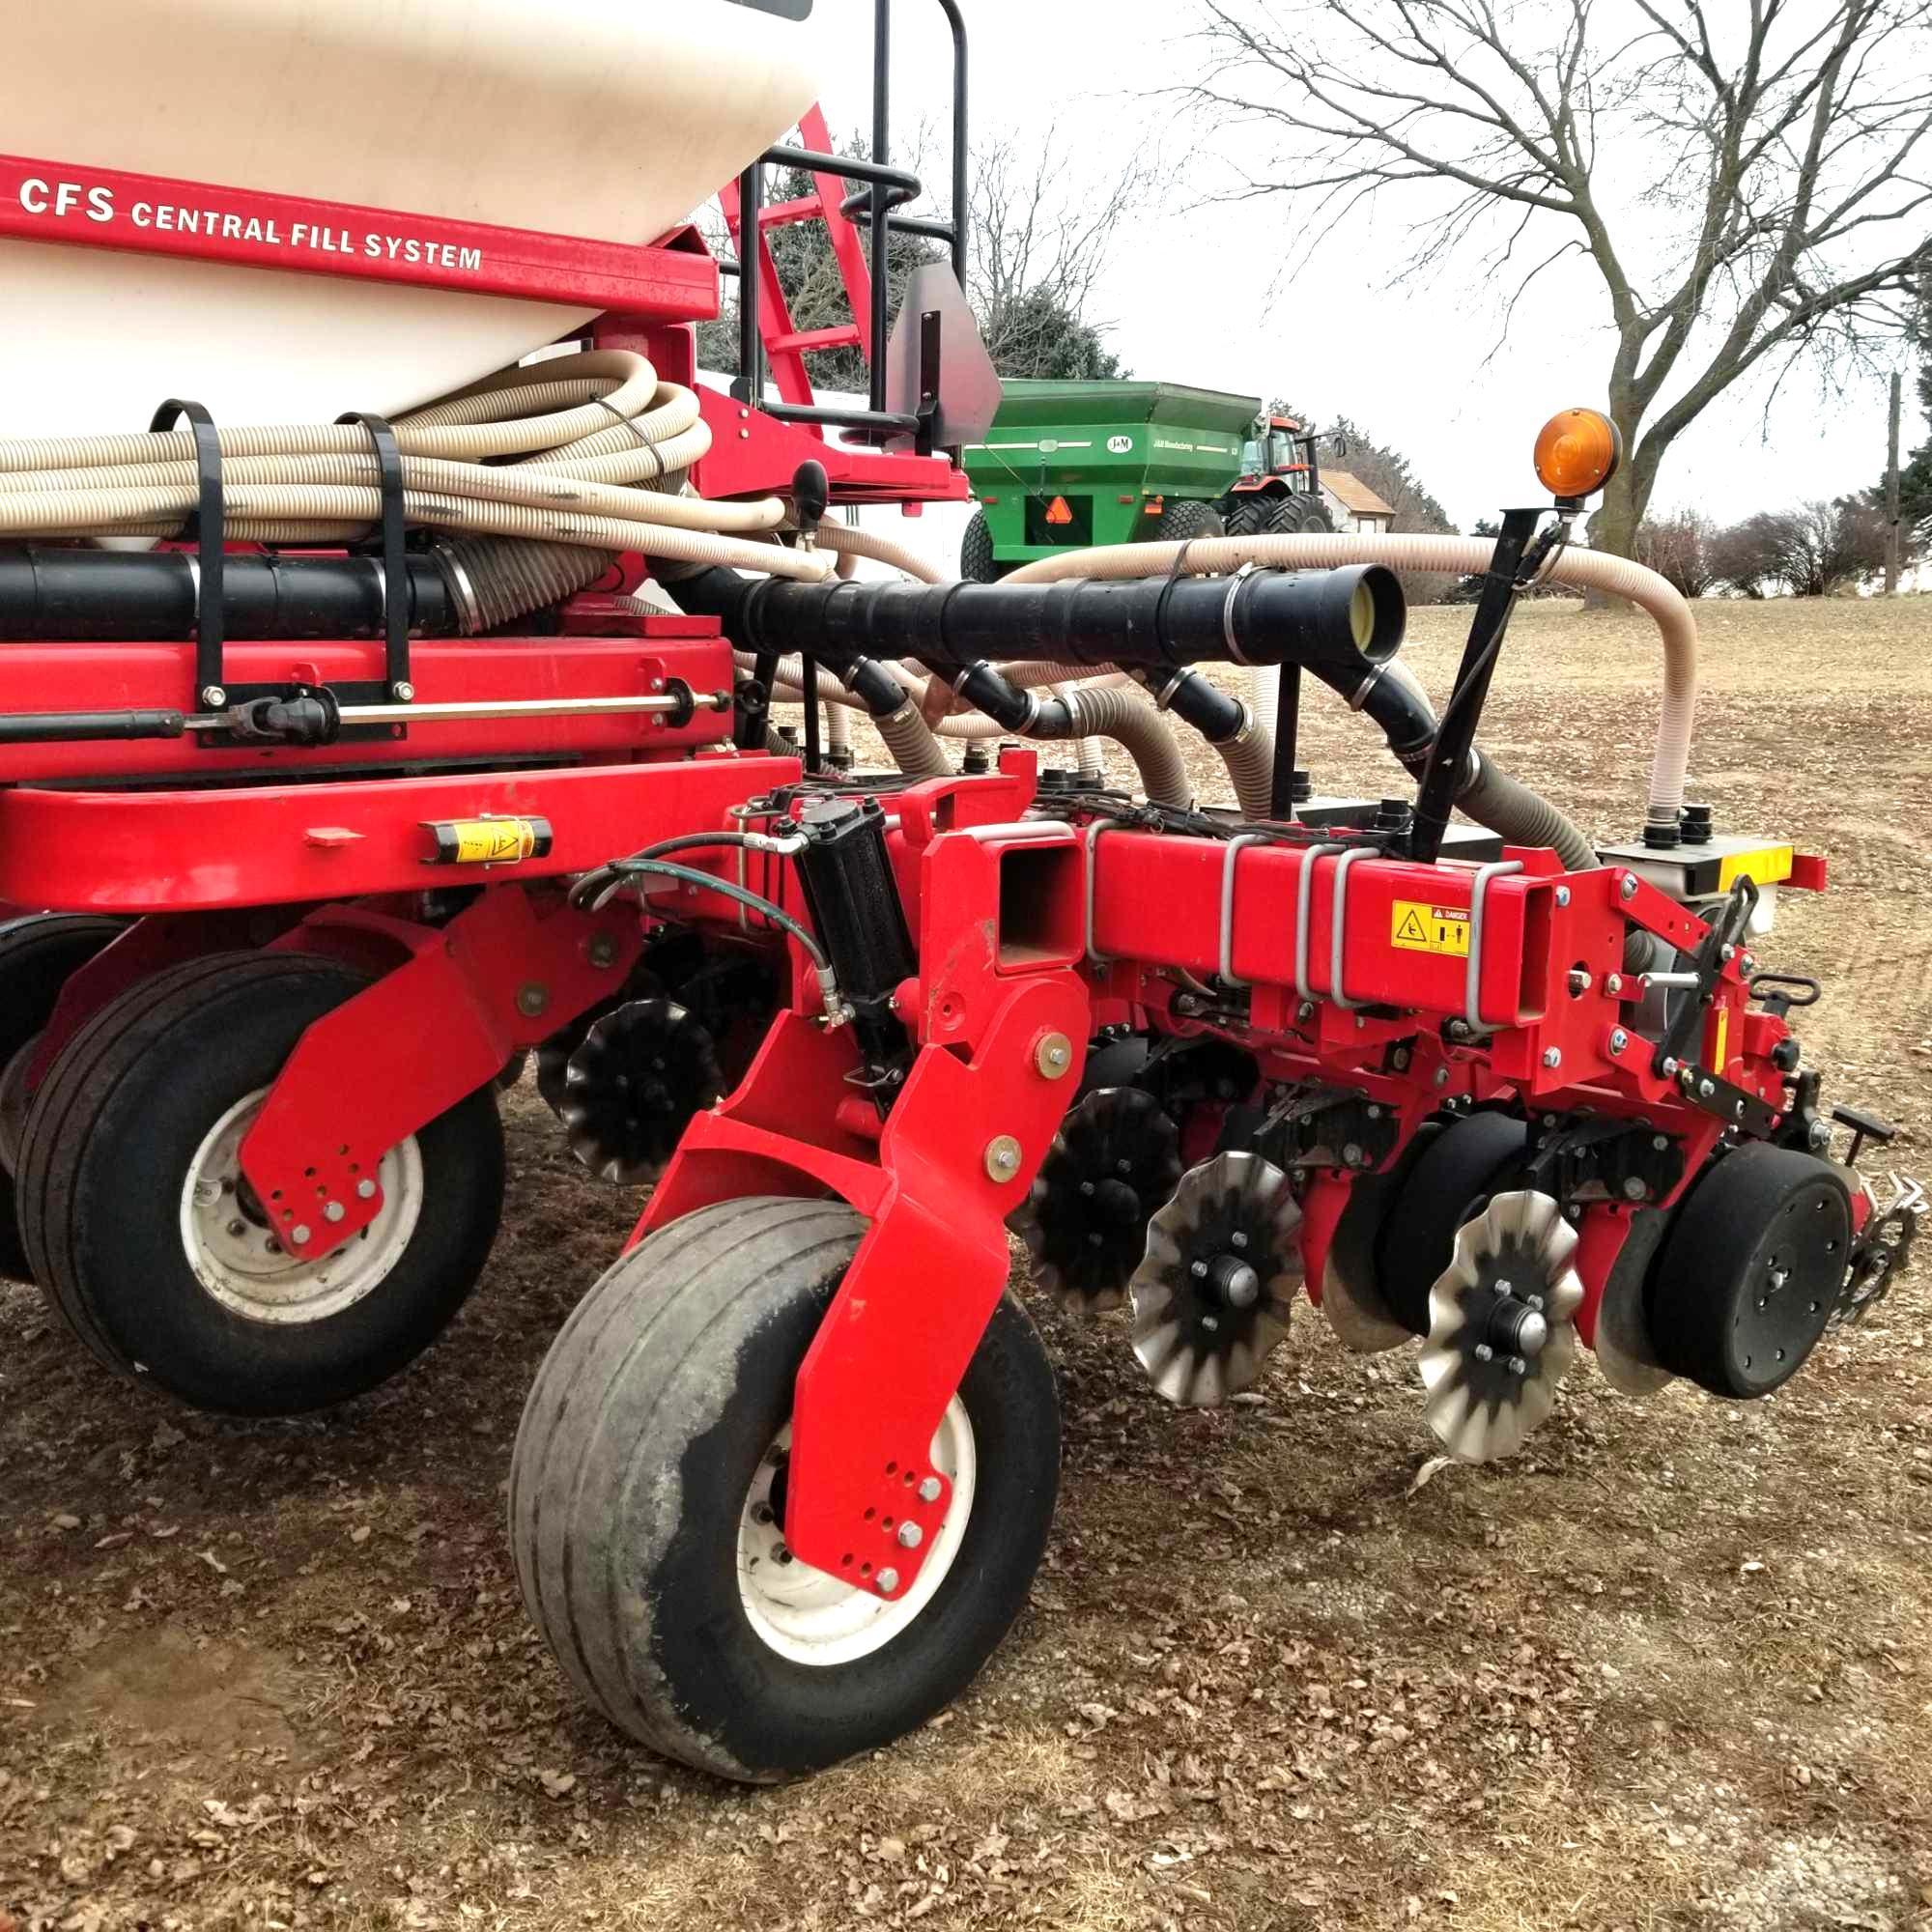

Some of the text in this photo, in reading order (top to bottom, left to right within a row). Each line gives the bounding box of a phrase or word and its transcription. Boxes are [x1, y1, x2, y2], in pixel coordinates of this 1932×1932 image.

[19, 178, 481, 271] CFS CENTRAL FILL SYSTEM
[1445, 910, 1468, 921] DANGER
